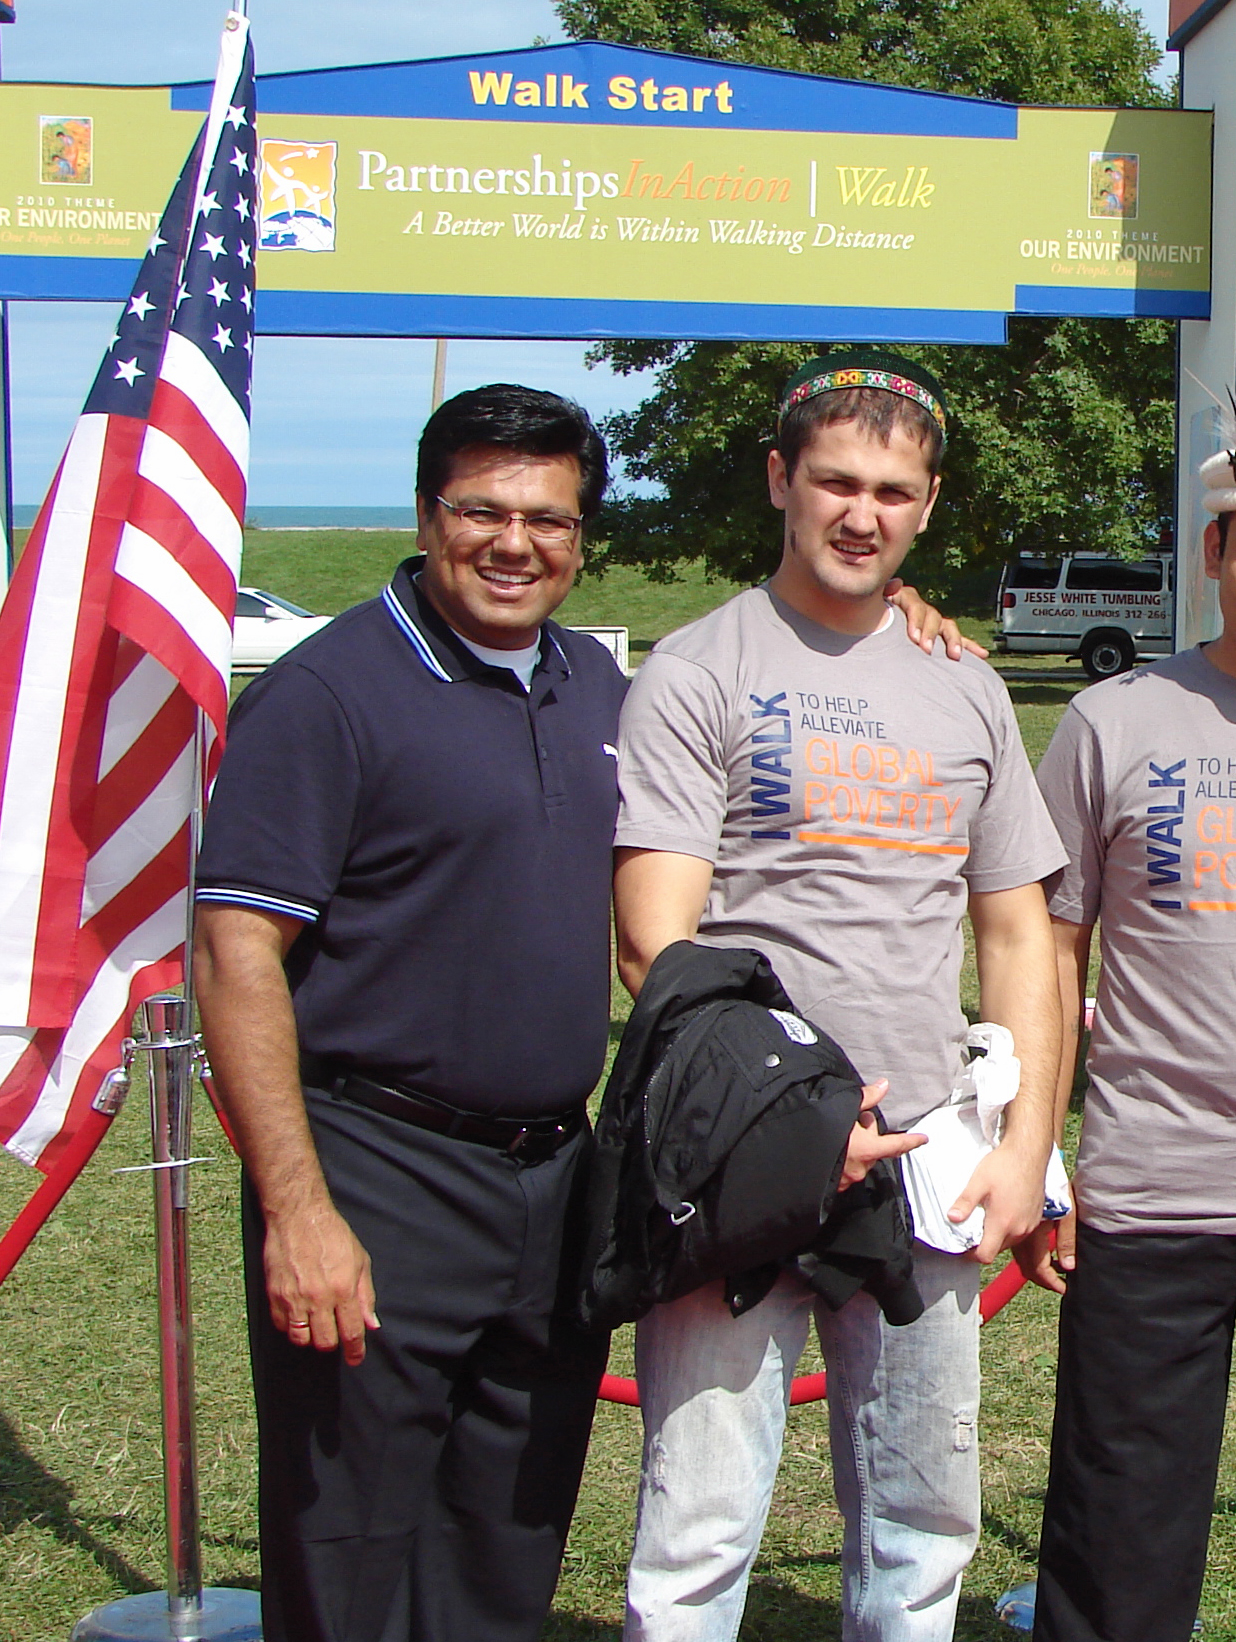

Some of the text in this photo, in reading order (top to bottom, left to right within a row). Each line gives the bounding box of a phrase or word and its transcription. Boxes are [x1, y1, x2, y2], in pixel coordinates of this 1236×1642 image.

[469, 71, 733, 113] Walk Start
[835, 165, 936, 208] Walk
[17, 195, 116, 208] 2010 THEME
[17, 208, 163, 231] ENVIRONMENT
[1, 230, 24, 243] One
[69, 233, 92, 244] One
[95, 234, 131, 246] Planet
[402, 211, 915, 254] A Better World is Within Walking Distance
[1066, 229, 1159, 242] 2010 THEME
[1020, 239, 1204, 264] OUR ENVIRONMENT
[1051, 263, 1074, 275] One
[1115, 265, 1137, 277] One
[1024, 592, 1161, 605] JESSE WHITE TUMBLING
[1082, 609, 1120, 618] ILLINOIS
[796, 692, 868, 715] TO HELP
[800, 717, 886, 739] ALLEVIATE
[750, 692, 791, 840] I WALK
[804, 737, 944, 787] GLOBAL
[1197, 758, 1221, 775] TO
[803, 781, 962, 832] POVERTY
[1146, 758, 1186, 909] I WALK
